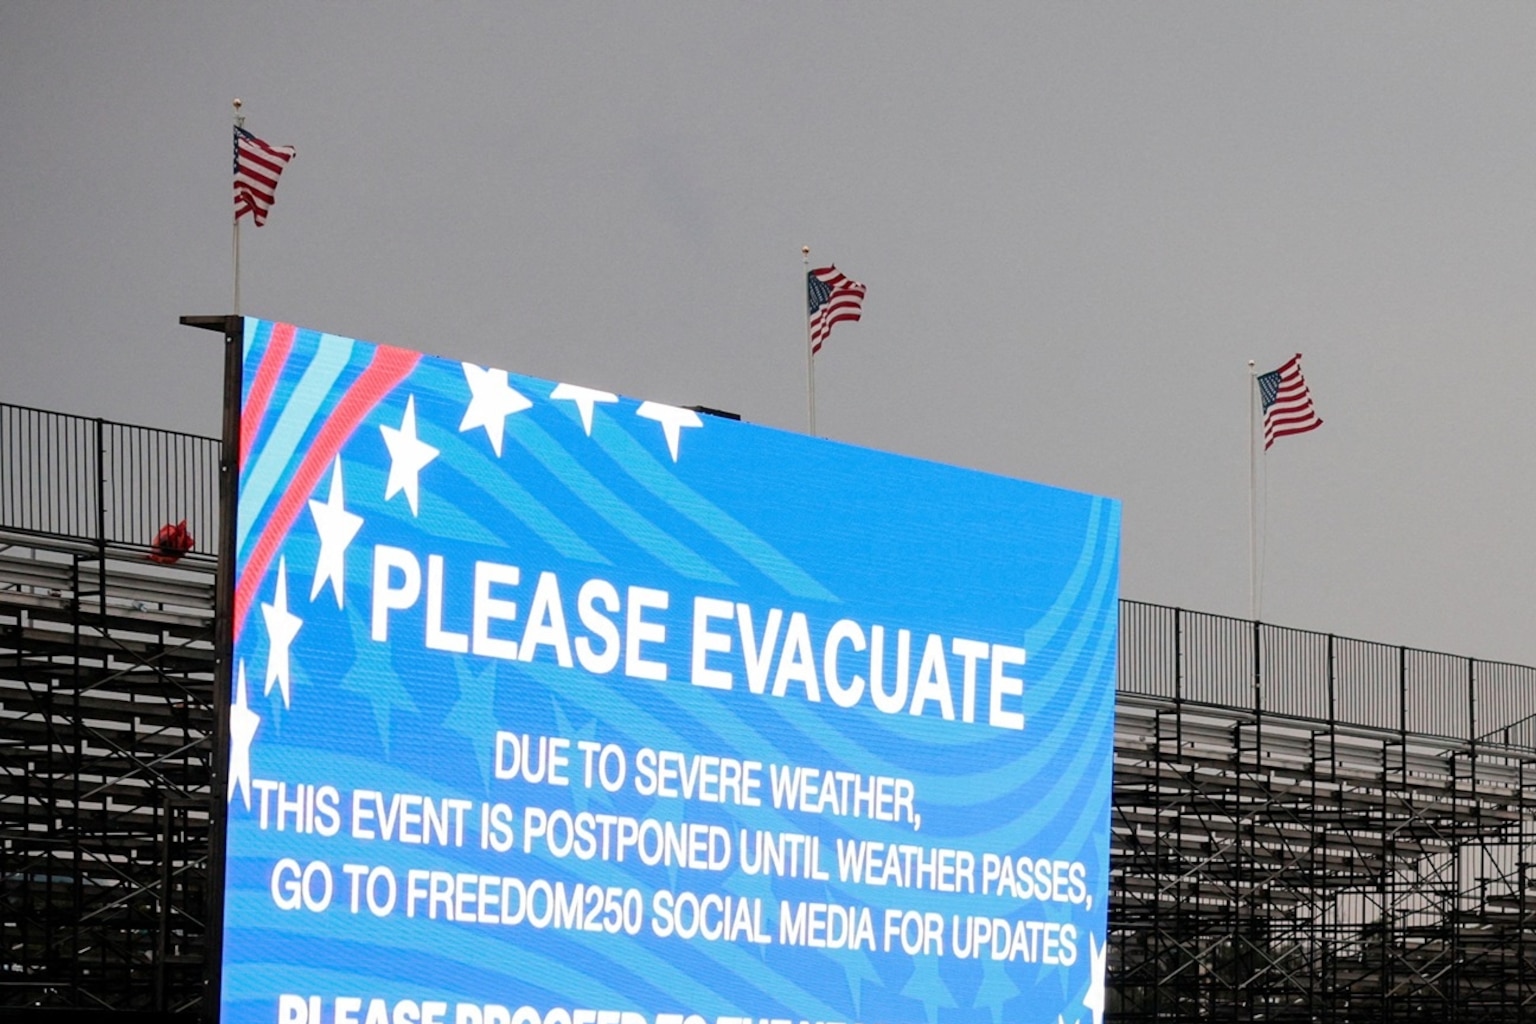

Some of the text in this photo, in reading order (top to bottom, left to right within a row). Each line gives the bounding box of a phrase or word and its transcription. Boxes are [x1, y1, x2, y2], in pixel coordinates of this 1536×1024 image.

[372, 545, 1027, 730] PLEASE EVACUATE
[495, 731, 921, 831] DUE TO SEVERE WEATHER,
[251, 779, 1093, 911] THIS EVENT IS POSTPONED UNTIL WEATHER PASSES,
[271, 859, 1078, 967] GO TO FREEDOM250 SOCIAL MEDIA FOR UPDATES
